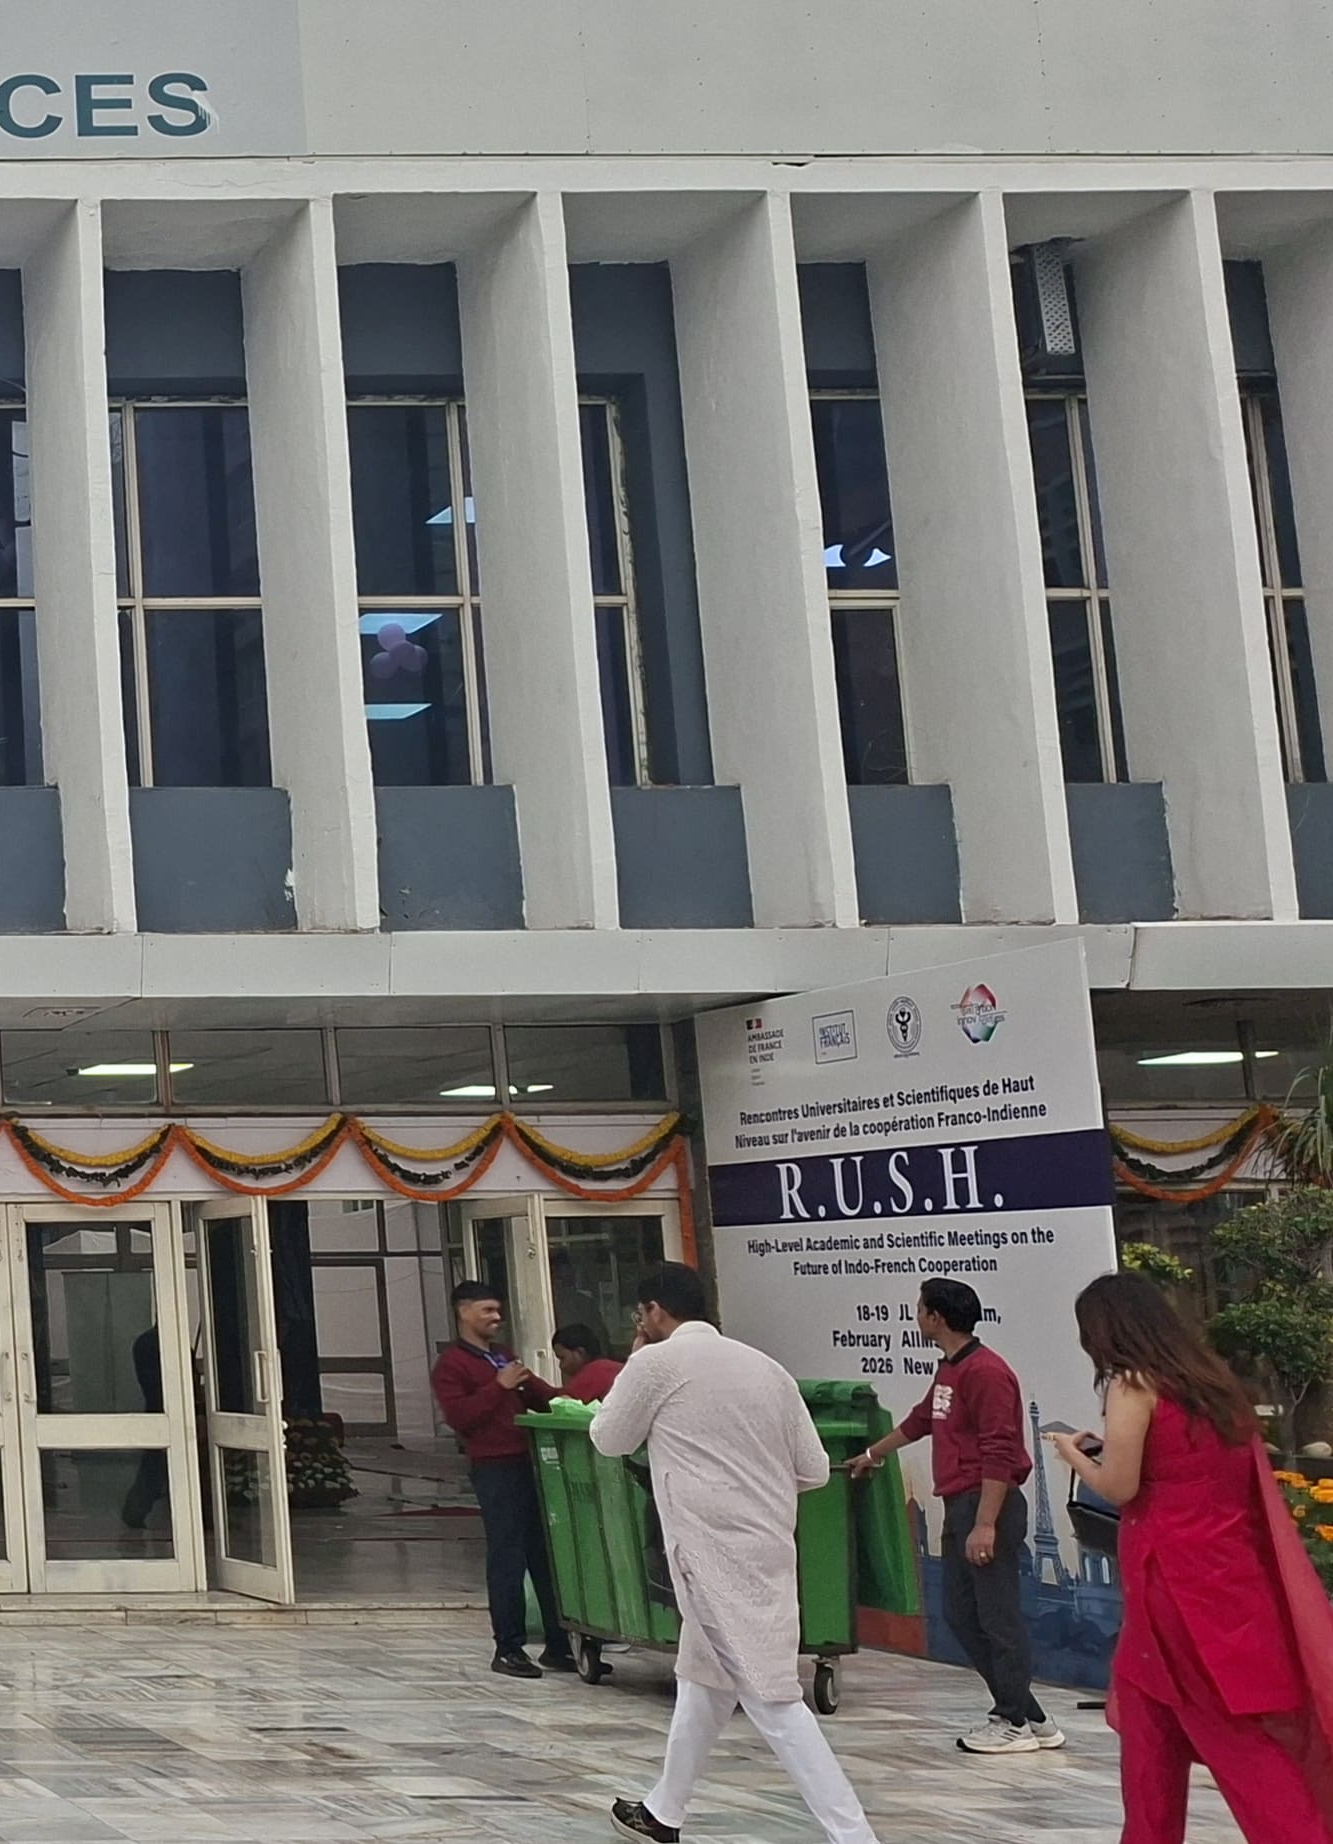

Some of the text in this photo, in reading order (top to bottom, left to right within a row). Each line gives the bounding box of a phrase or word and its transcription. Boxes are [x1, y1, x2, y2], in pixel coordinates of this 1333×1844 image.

[740, 1075, 1035, 1126] Rencontres Universitaires et Scientifiques de Haut
[735, 1103, 1047, 1149] Niveau sur l'avenir de la coopération Franco-Indienne
[775, 1146, 1003, 1219] R.U.S.H.
[747, 1226, 1054, 1257] High-Level Academic and Scientific Meetings on the
[793, 1255, 997, 1276] Future of Indo-French Cooperation
[857, 1304, 888, 1321] 18-19
[899, 1304, 913, 1321] JL
[833, 1330, 891, 1351] February
[902, 1330, 939, 1348] AIIM
[861, 1357, 893, 1374] 2026
[903, 1357, 934, 1375] New
